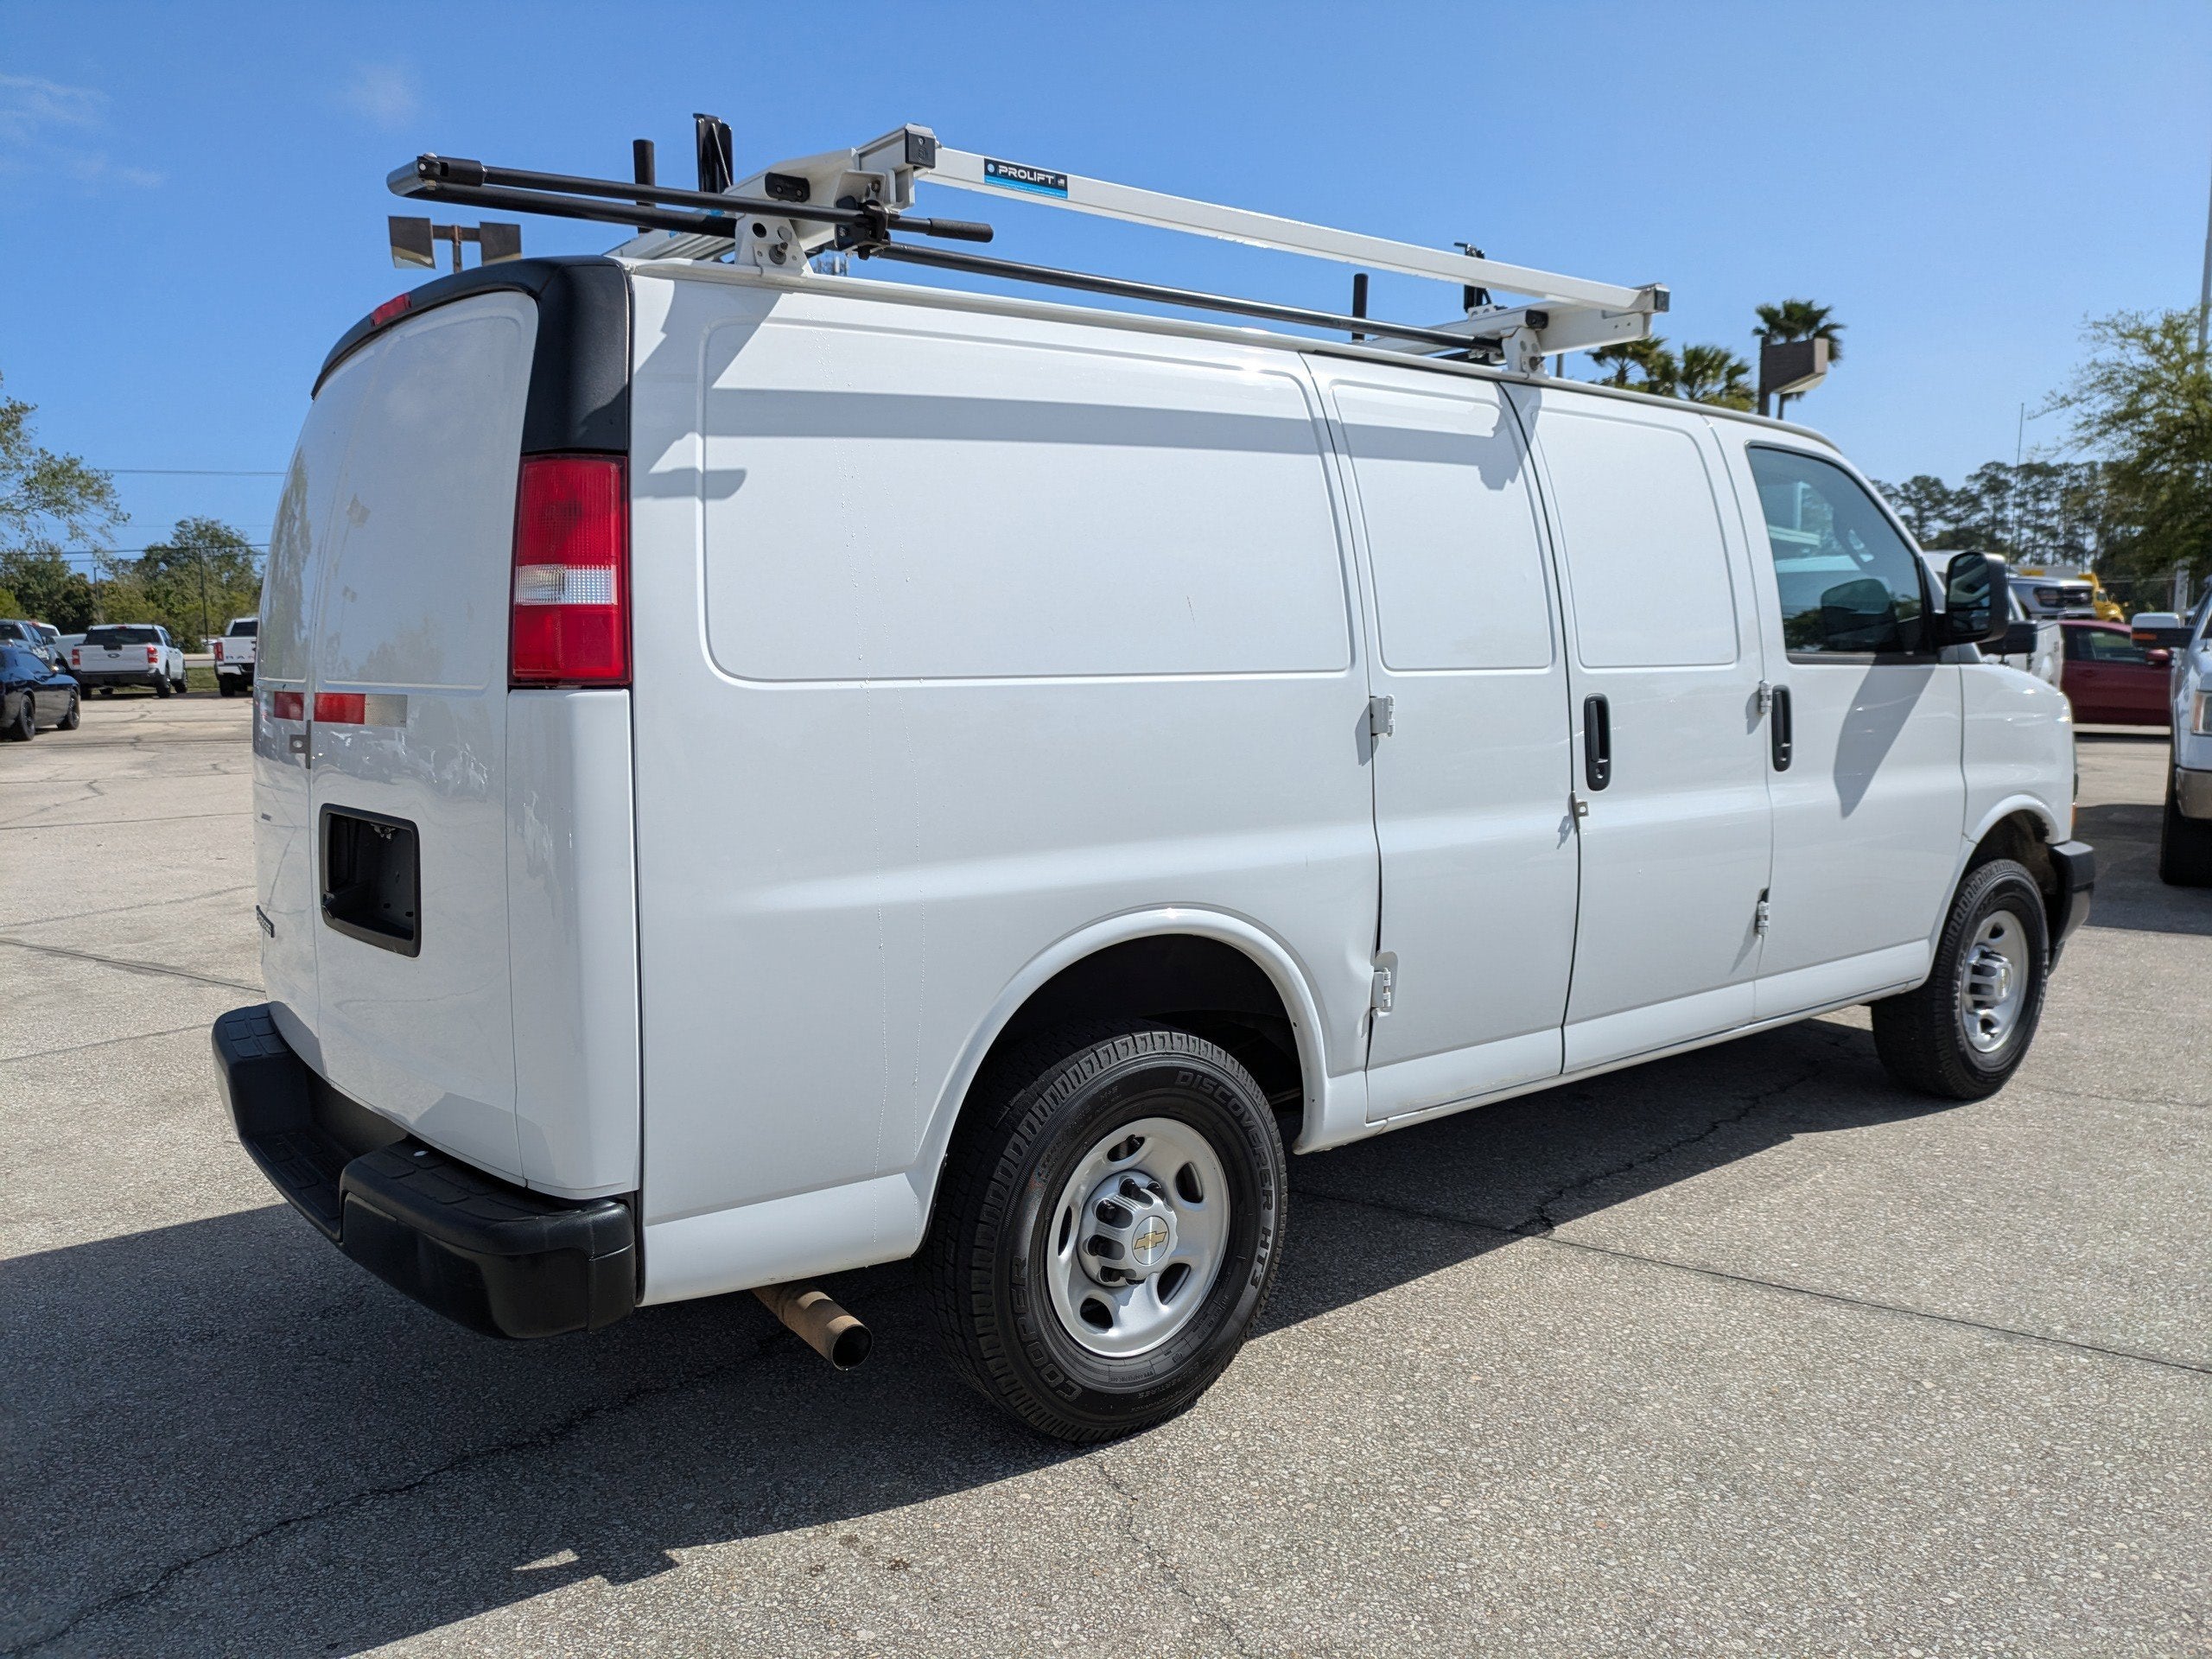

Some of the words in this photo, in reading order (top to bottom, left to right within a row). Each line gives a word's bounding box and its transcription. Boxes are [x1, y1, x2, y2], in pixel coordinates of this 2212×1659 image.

[998, 165, 1054, 184] PROLIFT
[1175, 1071, 1274, 1211] DISCOVERER
[1249, 1226, 1271, 1289] HT3
[1011, 1255, 1083, 1402] COOPER
